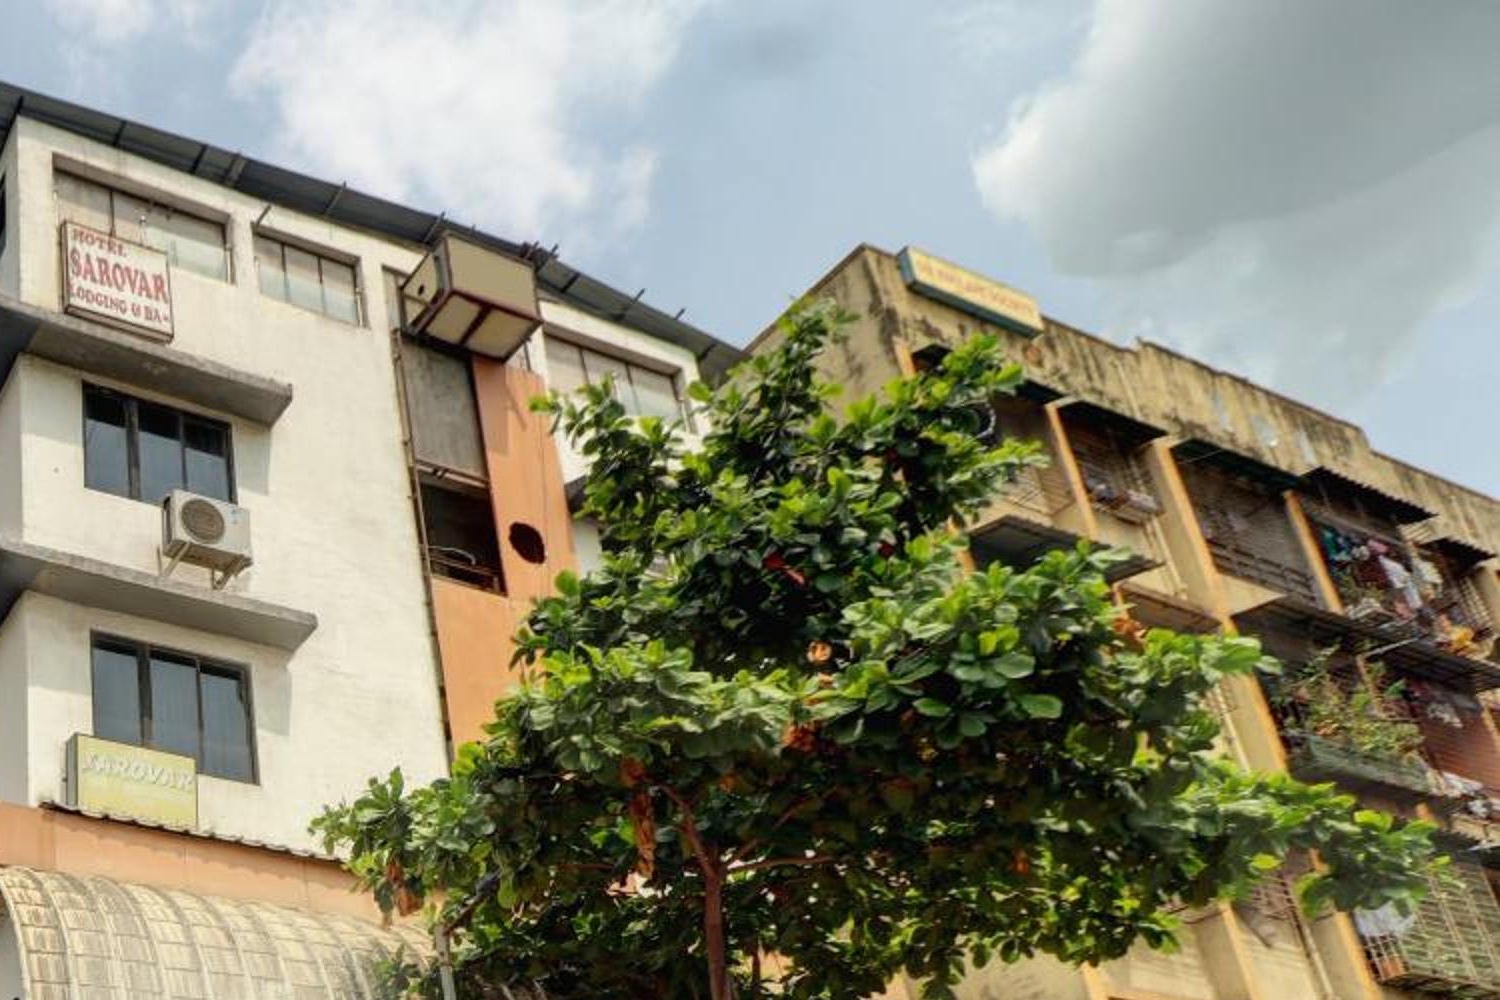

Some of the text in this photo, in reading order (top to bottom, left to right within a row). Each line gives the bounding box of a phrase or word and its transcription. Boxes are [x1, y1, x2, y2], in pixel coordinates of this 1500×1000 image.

[73, 227, 126, 258] HOTEL
[69, 246, 169, 304] SAROVAR
[67, 283, 127, 316] LODGING
